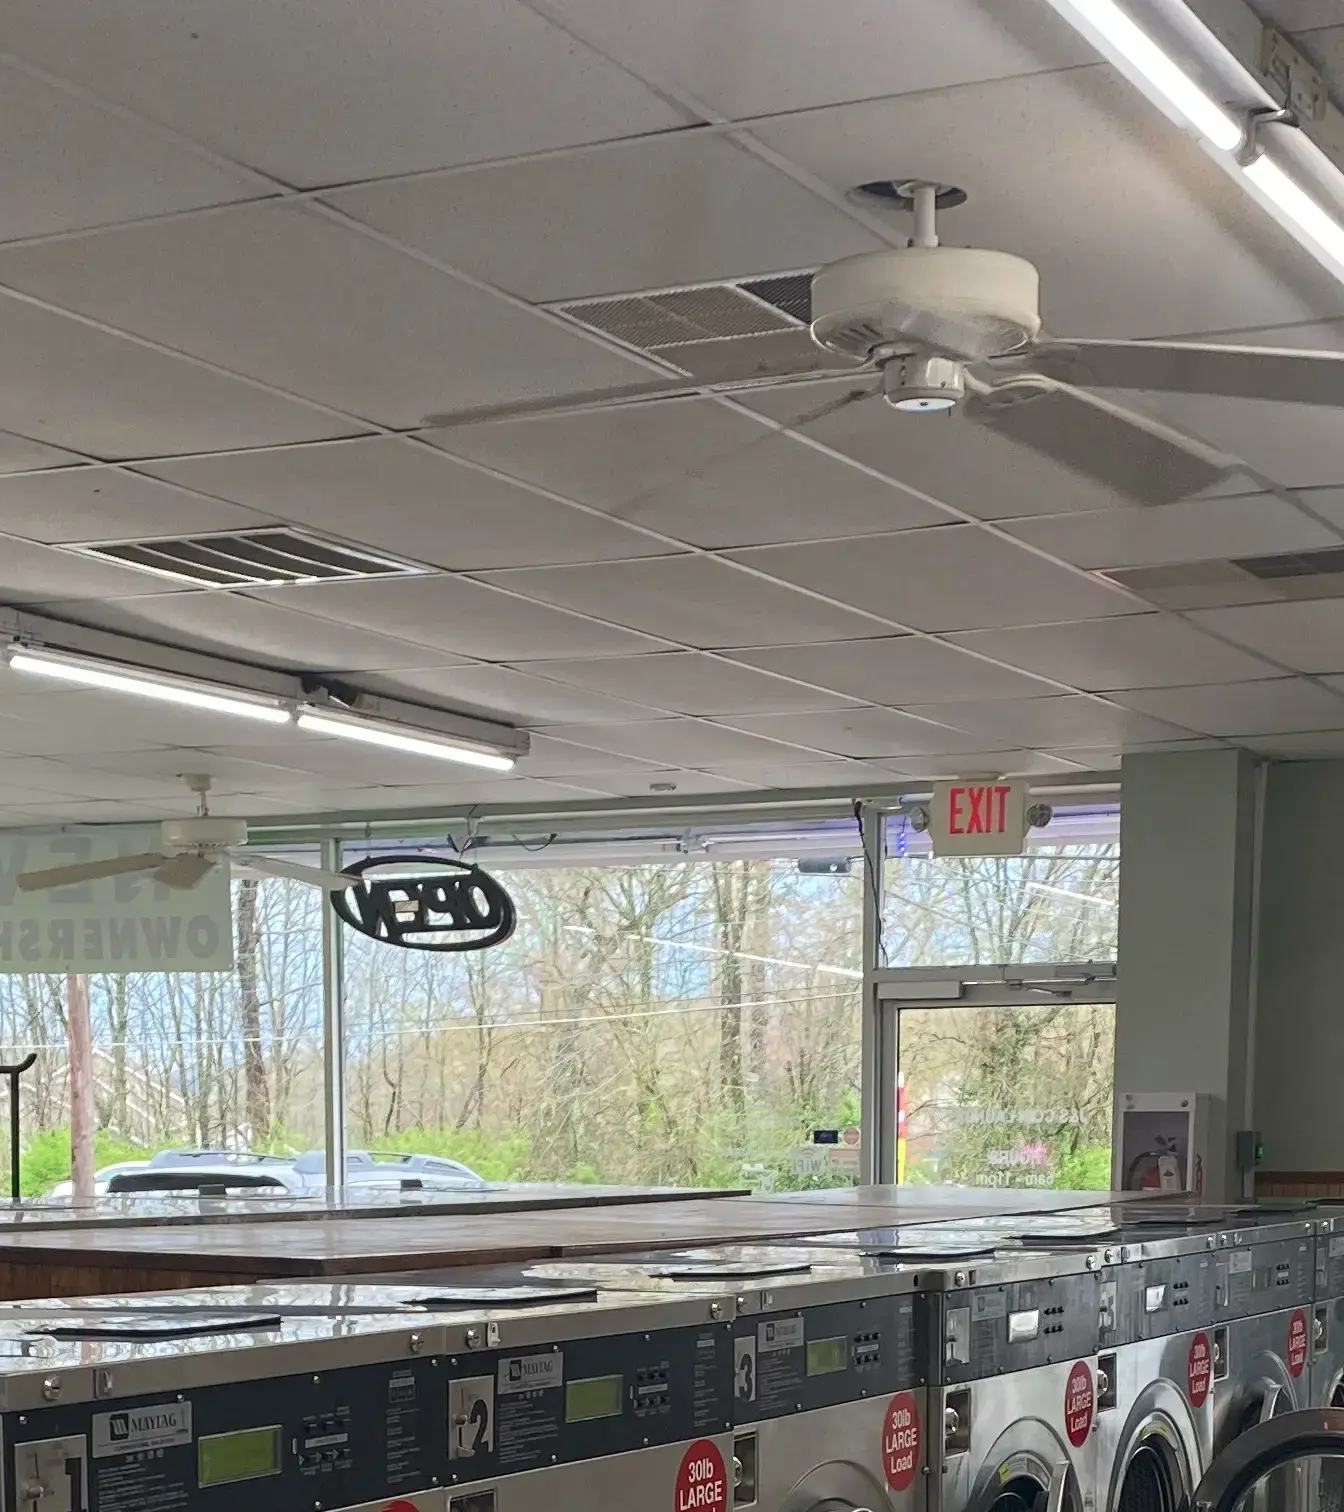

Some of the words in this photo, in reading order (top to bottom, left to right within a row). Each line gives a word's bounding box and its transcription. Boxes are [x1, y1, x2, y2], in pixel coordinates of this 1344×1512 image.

[949, 786, 1011, 835] EXIT
[739, 1353, 753, 1401] 3
[1189, 1358, 1210, 1378] LARGE
[1191, 1377, 1207, 1394] Load
[1067, 1391, 1092, 1415] LARGE
[130, 1412, 177, 1433] MAYTAG
[470, 1399, 490, 1451] 2
[892, 1409, 911, 1429] 30lb
[1070, 1411, 1088, 1433] Load
[885, 1427, 917, 1454] LARGE
[688, 1458, 714, 1483] 30lb
[890, 1452, 913, 1474] Load
[679, 1479, 723, 1511] LARGE
